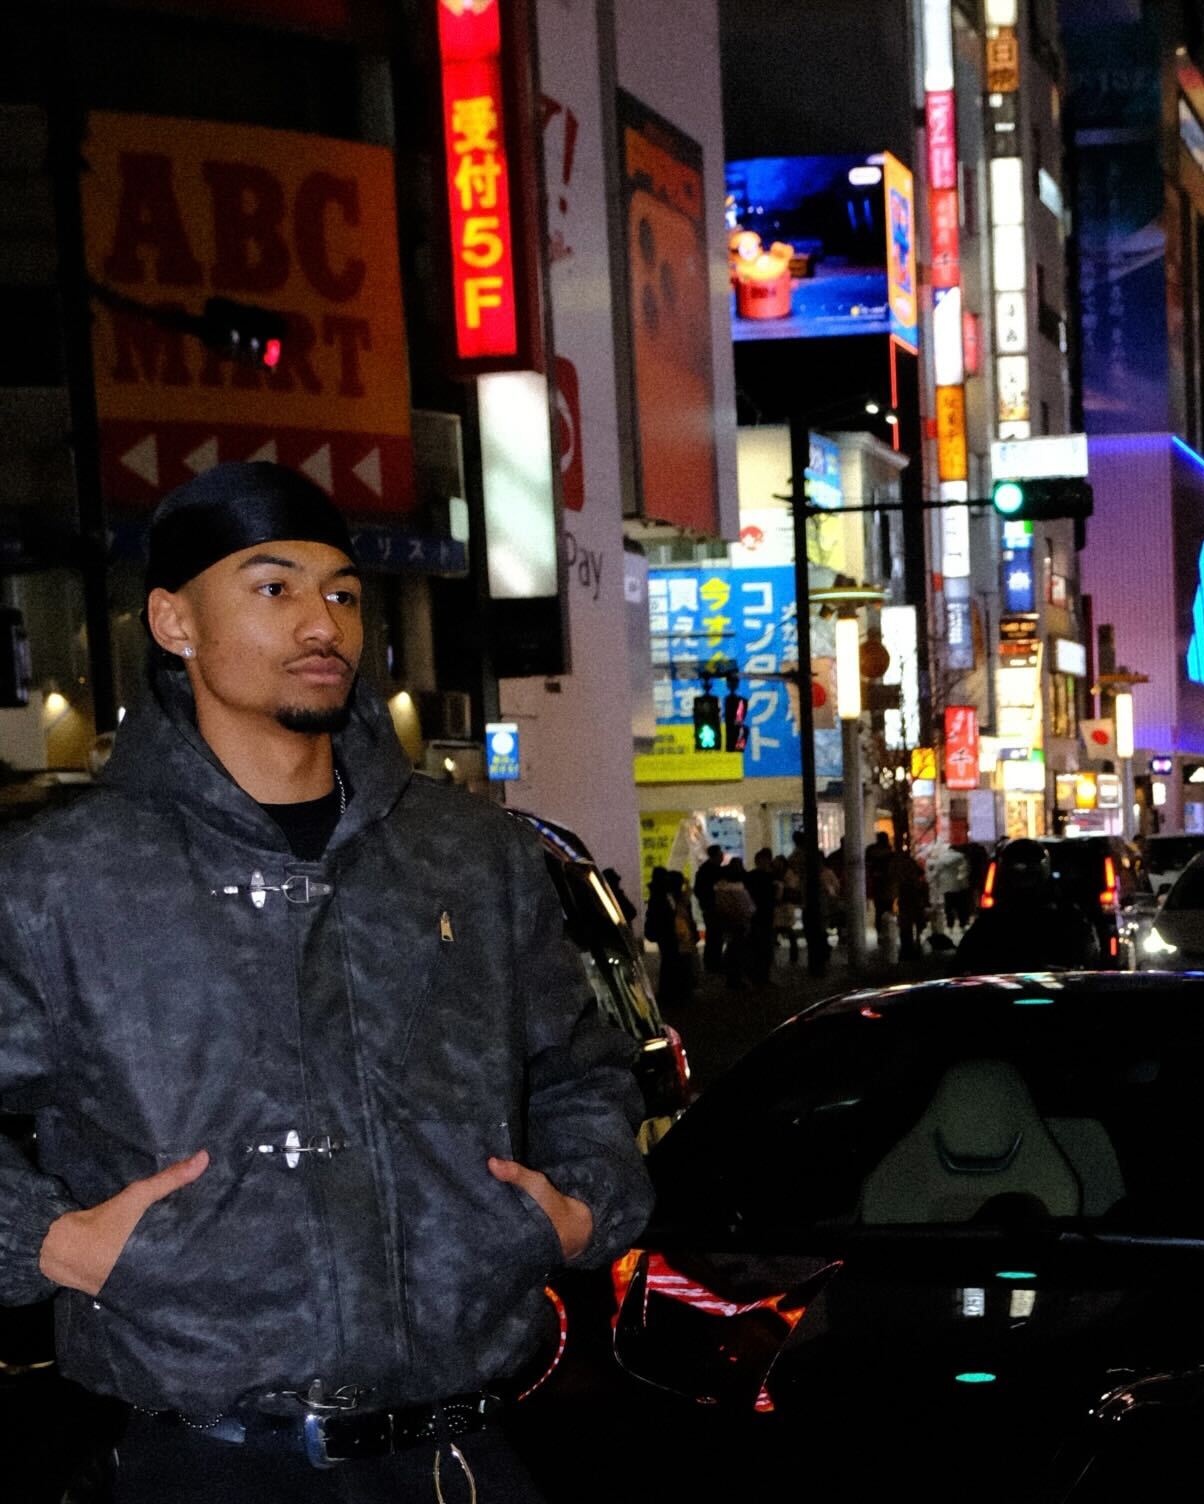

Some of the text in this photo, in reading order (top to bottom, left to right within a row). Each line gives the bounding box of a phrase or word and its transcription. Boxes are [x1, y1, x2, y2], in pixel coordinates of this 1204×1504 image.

[104, 152, 367, 302] ABC
[452, 96, 503, 329] 受付5F
[741, 581, 780, 761] コンタクト
